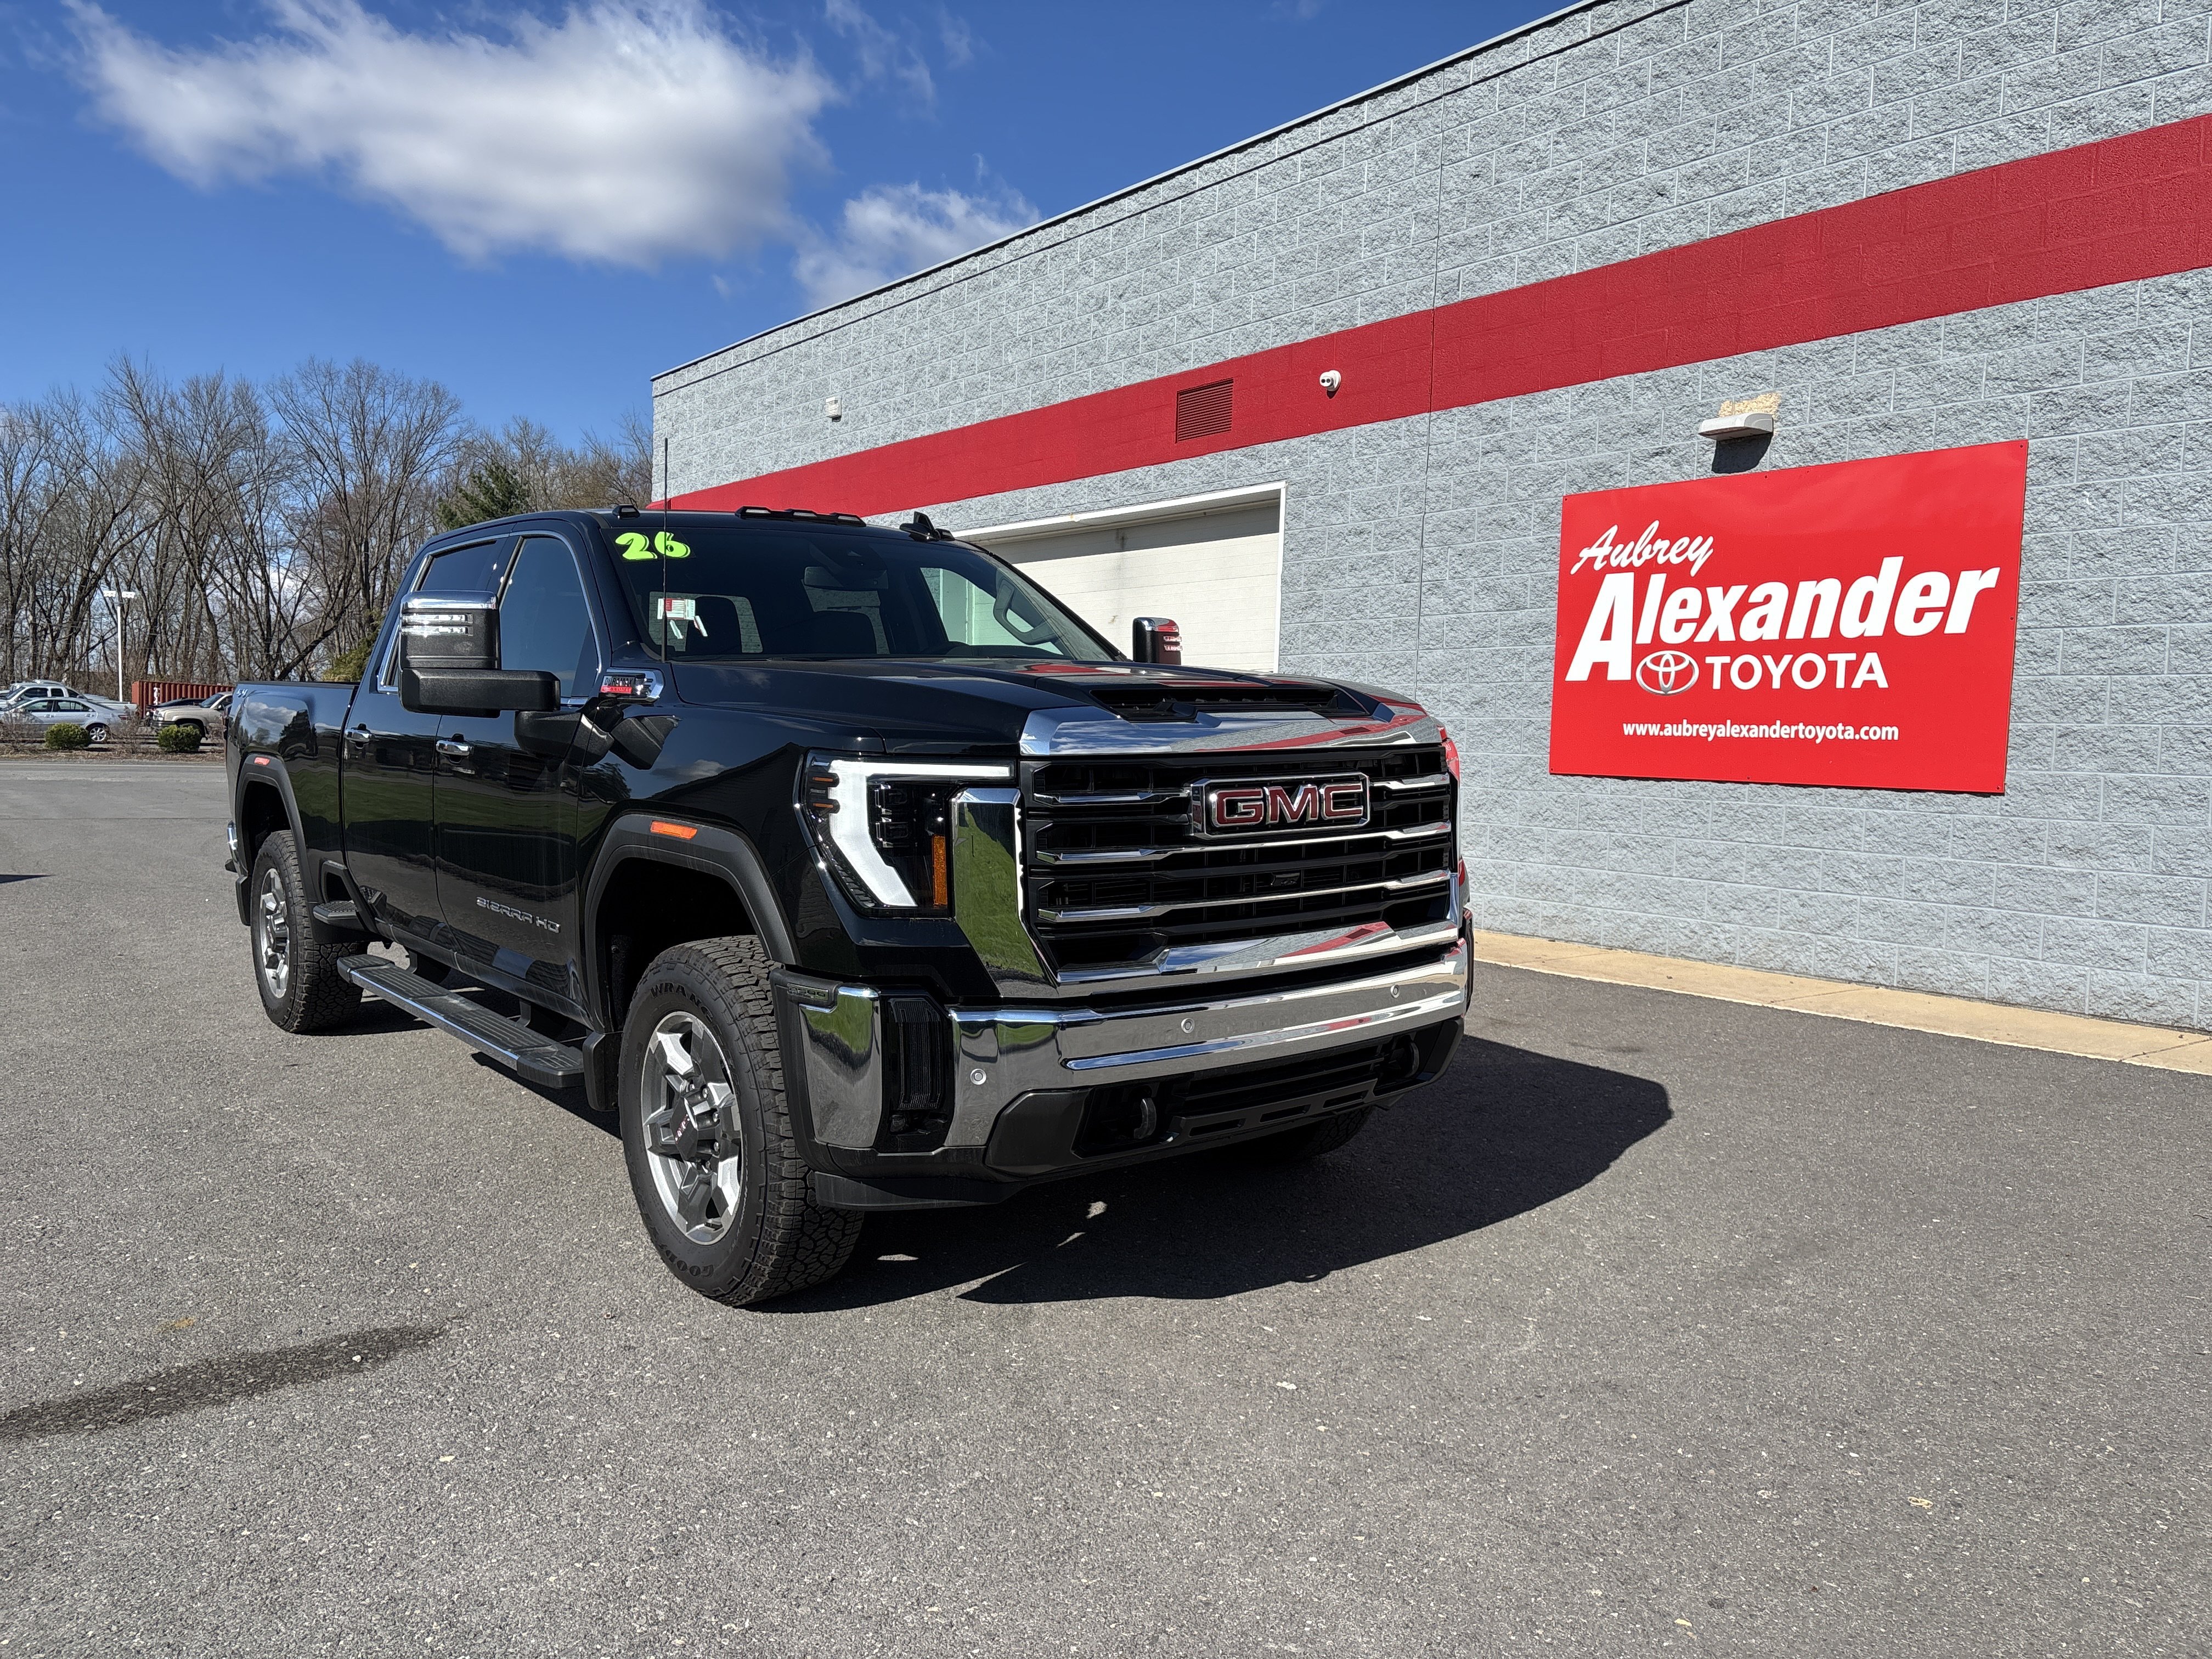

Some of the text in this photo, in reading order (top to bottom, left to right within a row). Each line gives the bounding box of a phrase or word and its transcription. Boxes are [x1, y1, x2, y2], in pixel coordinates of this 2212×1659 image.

[615, 532, 690, 560] 26
[1570, 520, 1714, 577] Aubrey
[1565, 556, 2001, 681] Alexander
[603, 677, 634, 687] DURAMAX
[1706, 652, 1889, 690] TOYOTA
[1623, 719, 1899, 744] www.aubreyalexandertoyota.com
[1211, 782, 1364, 827] GMC
[476, 896, 561, 934] SIERRA HD
